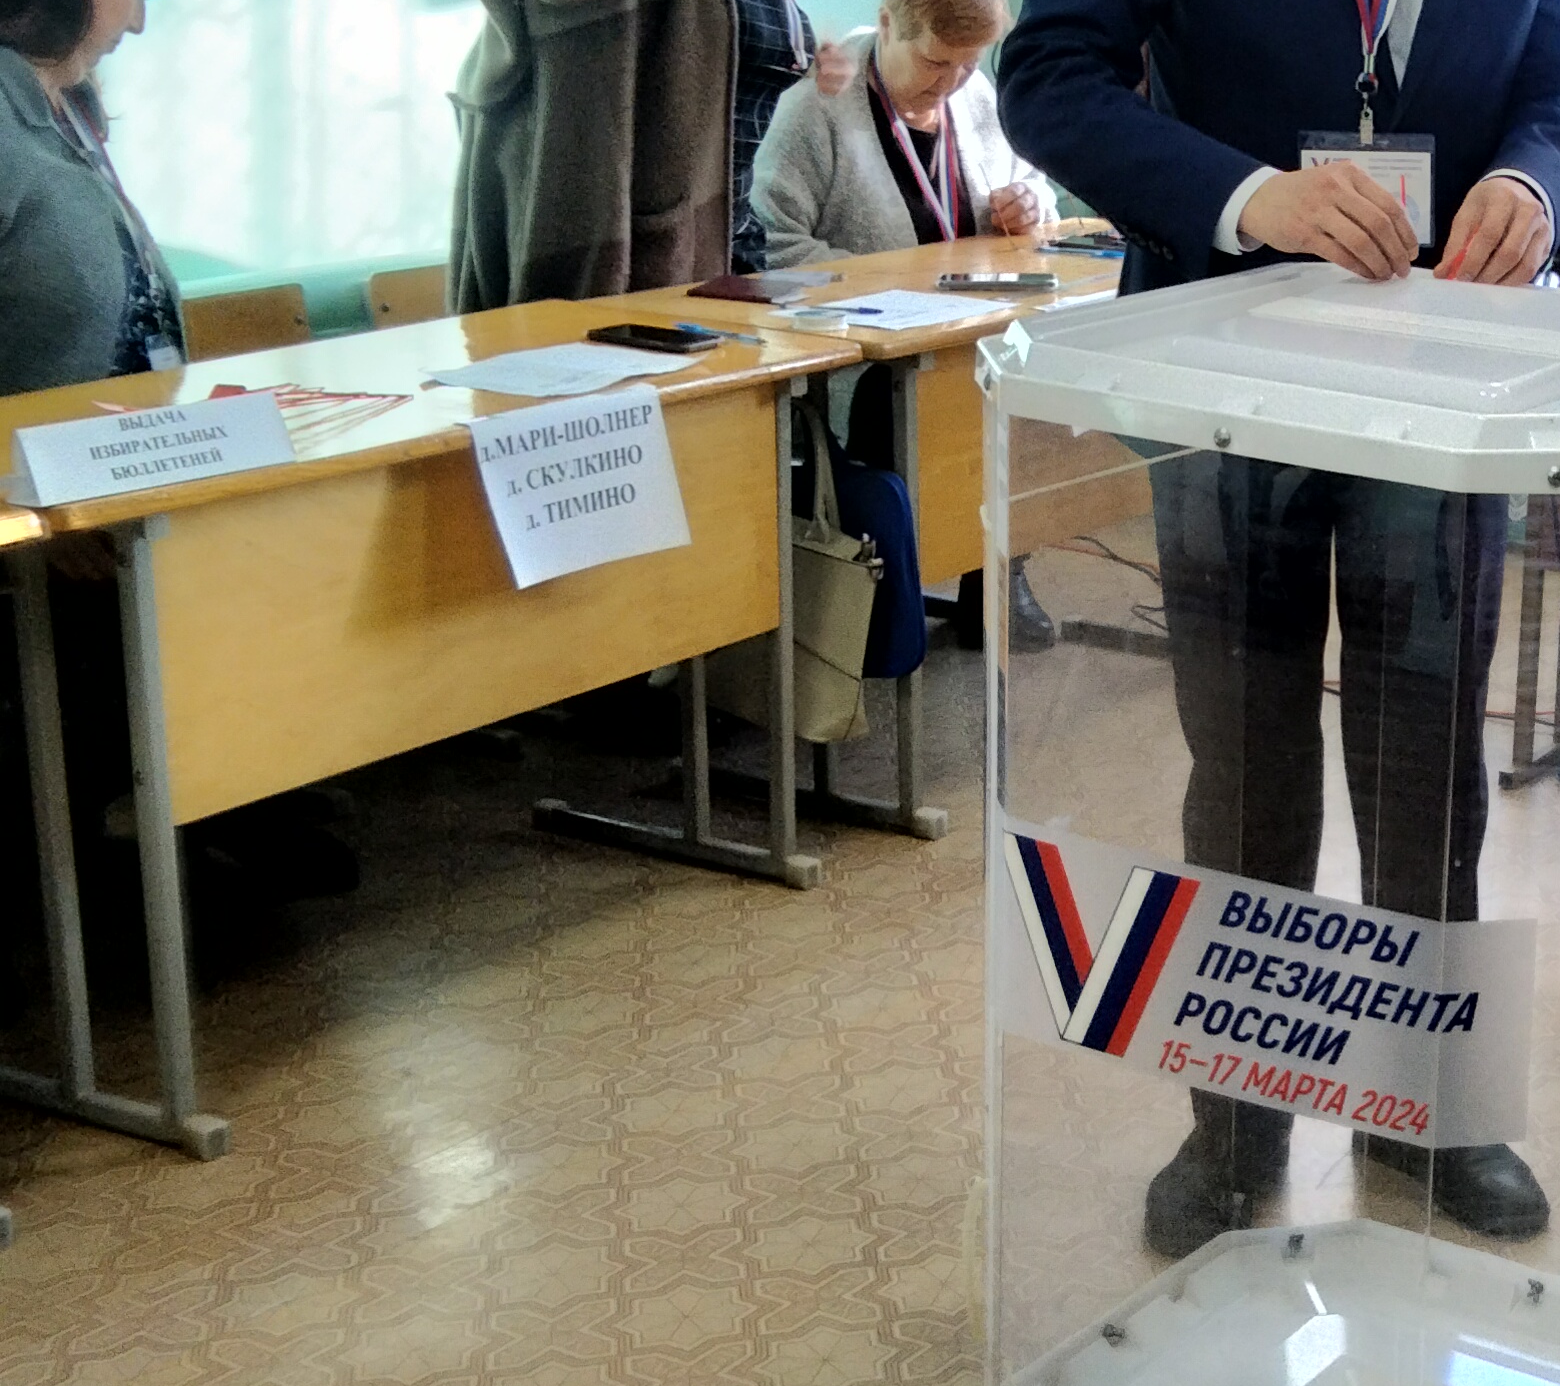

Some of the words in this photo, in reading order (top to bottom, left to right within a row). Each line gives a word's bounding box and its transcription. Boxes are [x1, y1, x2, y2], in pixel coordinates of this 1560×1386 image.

[89, 425, 229, 461] ИЗБИРАТЕЛЬНЫХ
[118, 410, 187, 432] ВЫДАЧА
[480, 403, 653, 463] д.МАРИ-ШОЛНЕР
[110, 447, 225, 481] БЮЛЛЕТЕНЕЙ
[507, 480, 522, 498] д.
[525, 444, 643, 490] СКУЛКИНО
[526, 514, 541, 531] д.
[543, 483, 636, 525] ТИМИНО
[1219, 890, 1421, 967] ВЫБОРЫ
[1195, 941, 1481, 1034] ПРЕЗИДЕНТА
[1173, 991, 1352, 1066] РОССИИ
[1241, 1061, 1349, 1117] МАРТА
[1350, 1088, 1430, 1136] 2024
